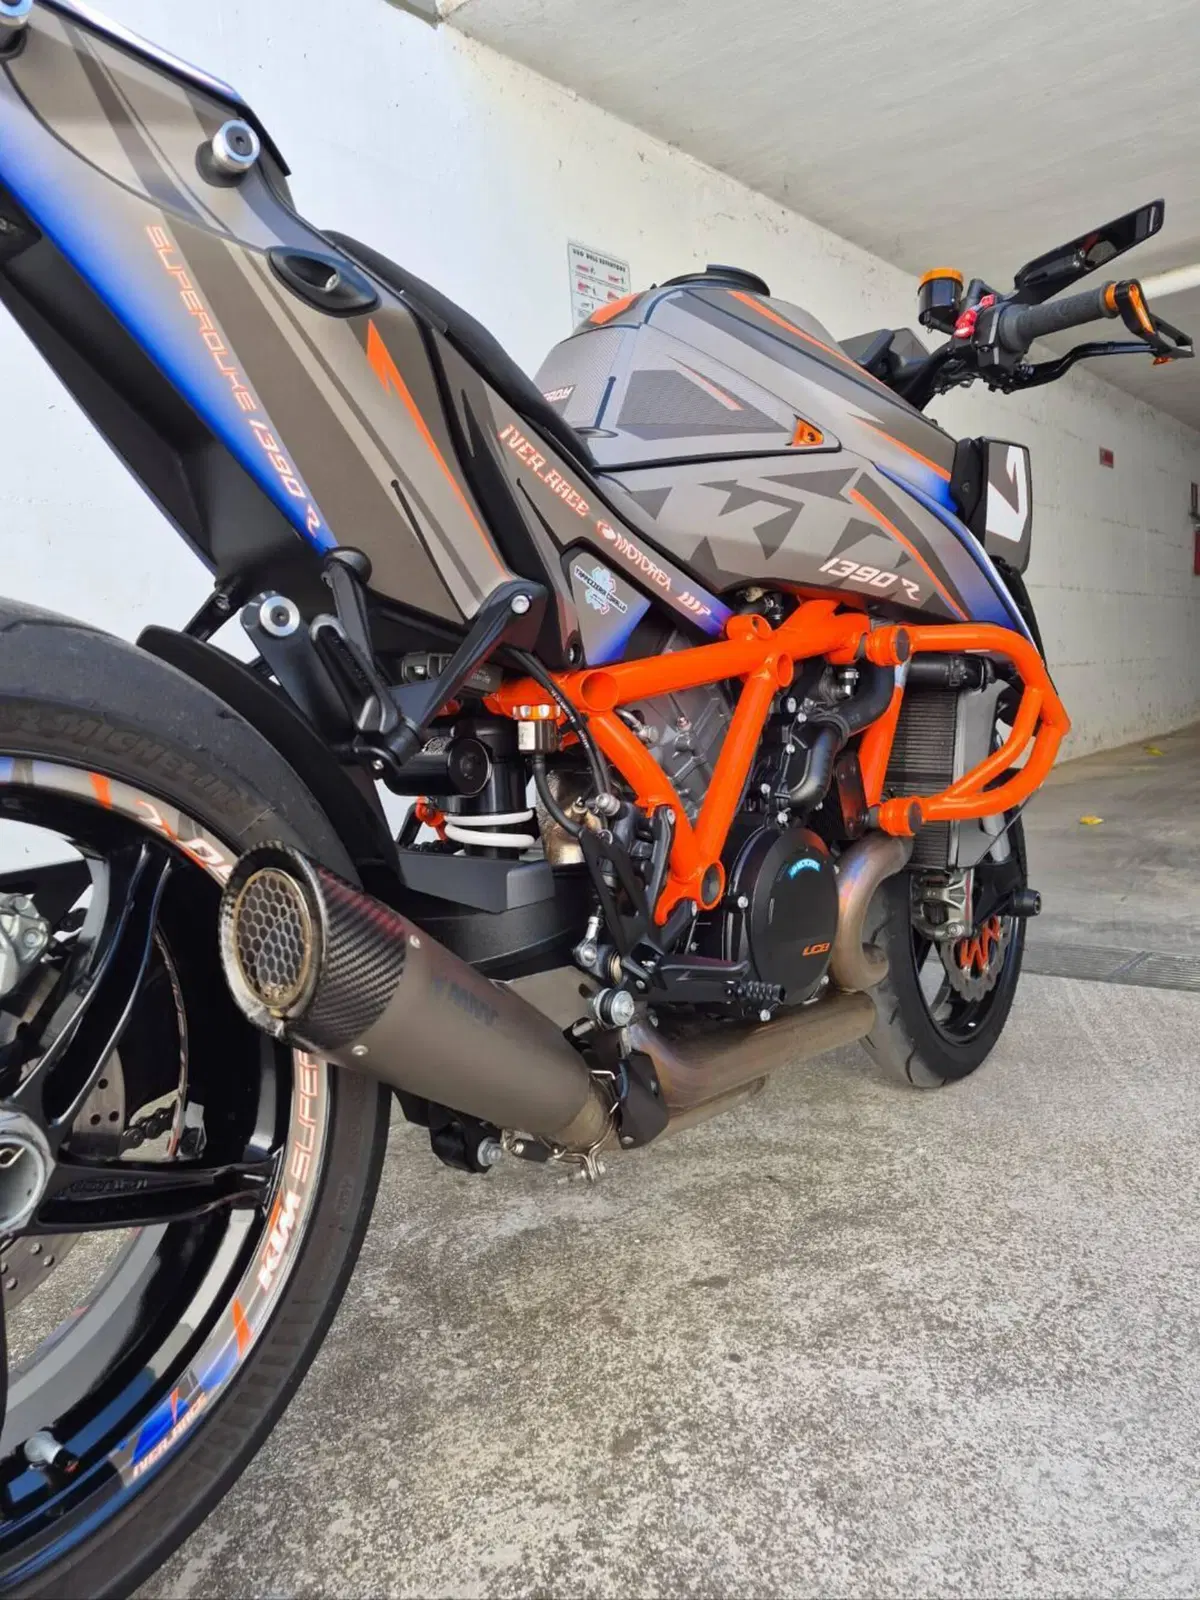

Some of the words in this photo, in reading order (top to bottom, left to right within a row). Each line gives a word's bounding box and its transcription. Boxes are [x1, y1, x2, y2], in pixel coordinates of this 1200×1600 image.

[146, 224, 258, 412] SUPERDUKE
[249, 418, 306, 498] 1390
[613, 532, 673, 591] MOTOREX
[818, 557, 900, 588] 1390
[900, 578, 922, 602] R
[256, 1192, 301, 1292] KTM
